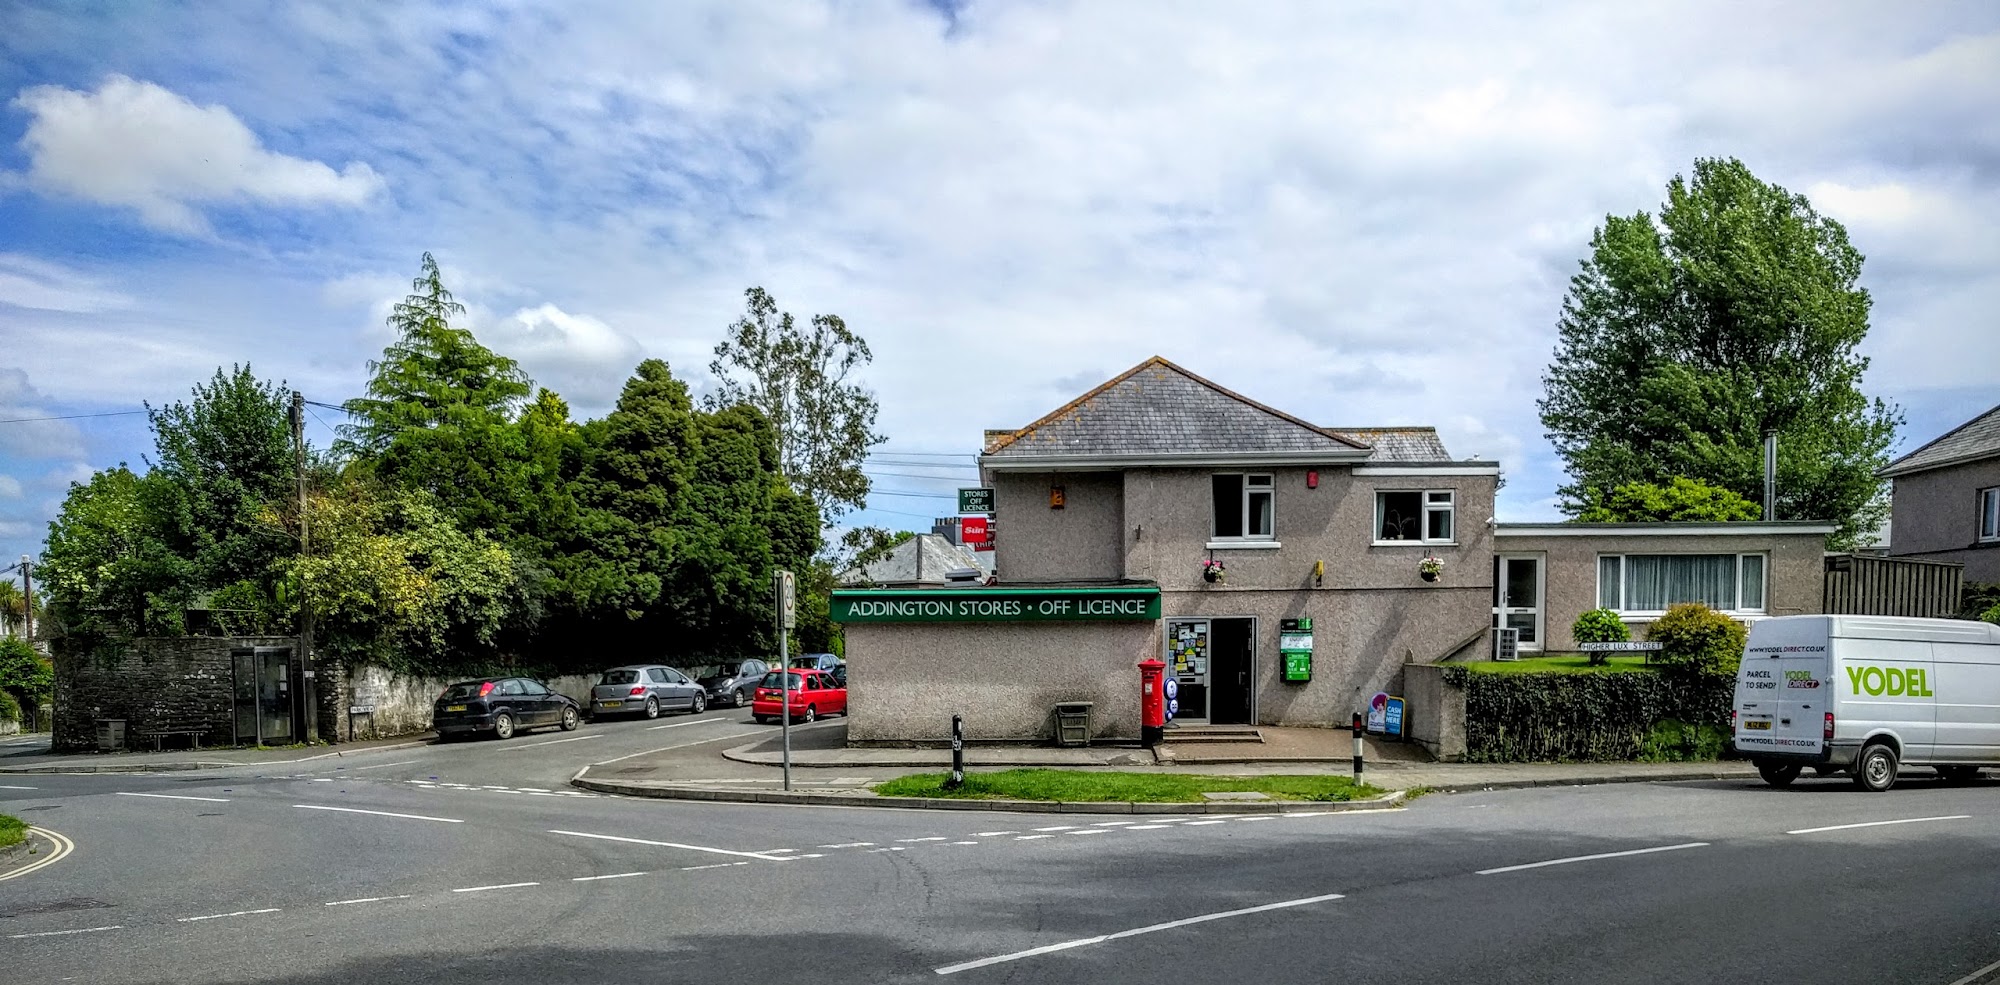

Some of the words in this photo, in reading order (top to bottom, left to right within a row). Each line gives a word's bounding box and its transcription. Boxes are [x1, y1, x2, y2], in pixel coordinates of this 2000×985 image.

[848, 601, 953, 616] ADDINGTON
[960, 600, 1021, 616] STORES
[1039, 600, 1071, 615] OFF
[1078, 599, 1146, 615] LICENCE
[1633, 642, 1661, 650] STREET
[1785, 671, 1811, 680] YODEL
[1745, 681, 1755, 689] TO
[1755, 681, 1777, 689] SEND?
[1789, 680, 1816, 688] DIRECT
[1845, 666, 1933, 697] YODEL
[1386, 716, 1400, 724] HERE
